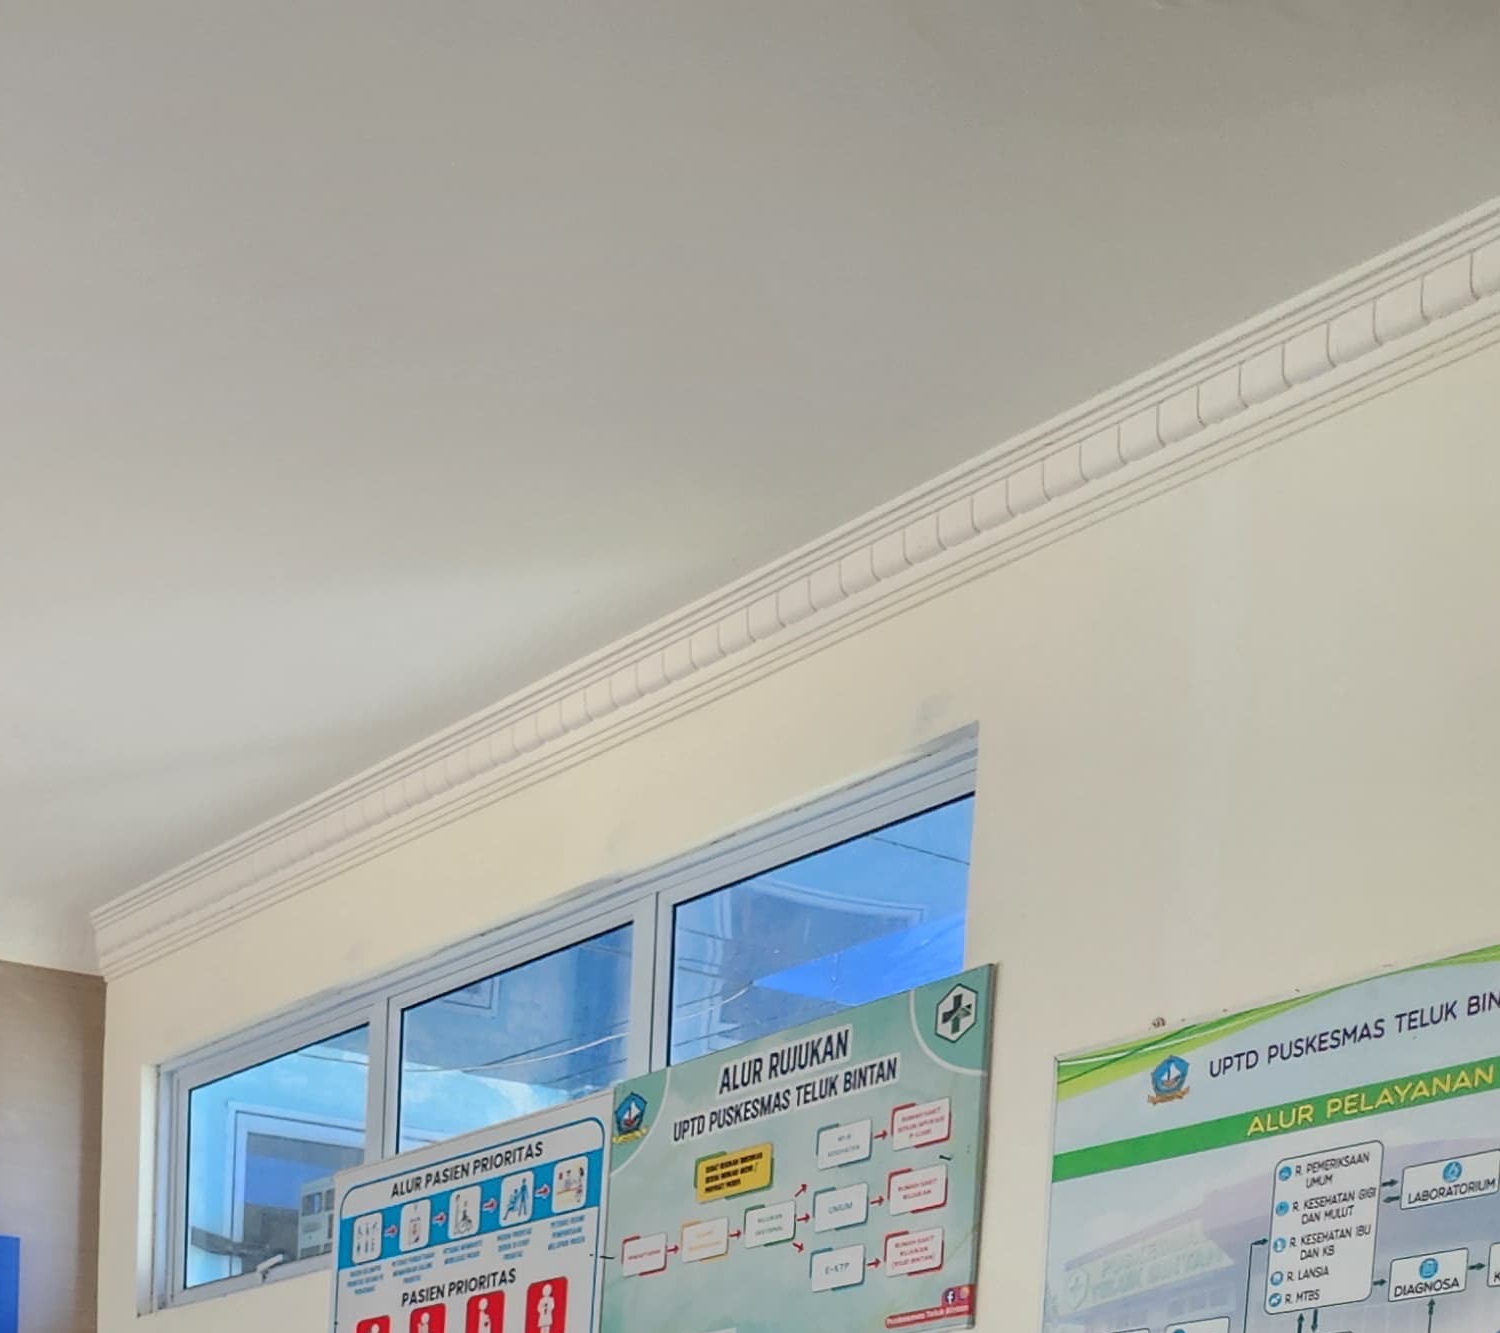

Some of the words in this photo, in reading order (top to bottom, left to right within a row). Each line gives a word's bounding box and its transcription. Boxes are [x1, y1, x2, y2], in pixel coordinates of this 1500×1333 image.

[1210, 1050, 1260, 1077] UPTD
[1268, 1019, 1385, 1064] PUSKESMAS
[1395, 1000, 1457, 1033] TELUK
[719, 1058, 762, 1094] ALUR
[768, 1029, 849, 1082] RUJUKAN
[673, 1114, 705, 1142] UPTD
[709, 1090, 791, 1130] PUSKESMAS
[795, 1075, 838, 1107] TELUK
[843, 1057, 897, 1093] BINTAN
[1248, 1104, 1314, 1136] ALUR
[1326, 1064, 1494, 1119] PELAYANAN
[391, 1177, 421, 1198] ALUR
[425, 1163, 470, 1188] PASIEN
[472, 1141, 543, 1177] PRIORITAS
[1307, 1152, 1370, 1174] PEMERIKSAAN
[1306, 1175, 1333, 1189] UMUM
[1408, 1178, 1495, 1204] LABORATORIUM
[1304, 1192, 1355, 1211] KESEHATAN
[1358, 1187, 1376, 1200] GIGI
[1301, 1212, 1321, 1225] DAN
[1324, 1205, 1354, 1220] MULUT
[1301, 1229, 1352, 1246] KESEHATAN
[1356, 1224, 1371, 1236] IBU
[1300, 1248, 1319, 1261] DAN
[1322, 1245, 1335, 1256] KB
[1298, 1266, 1329, 1281] LANSIA
[401, 1288, 445, 1307] PASIEN
[447, 1268, 517, 1296] PRIORITAS
[1296, 1289, 1320, 1301] MTBS
[1394, 1278, 1460, 1297] DIAGNOSA
